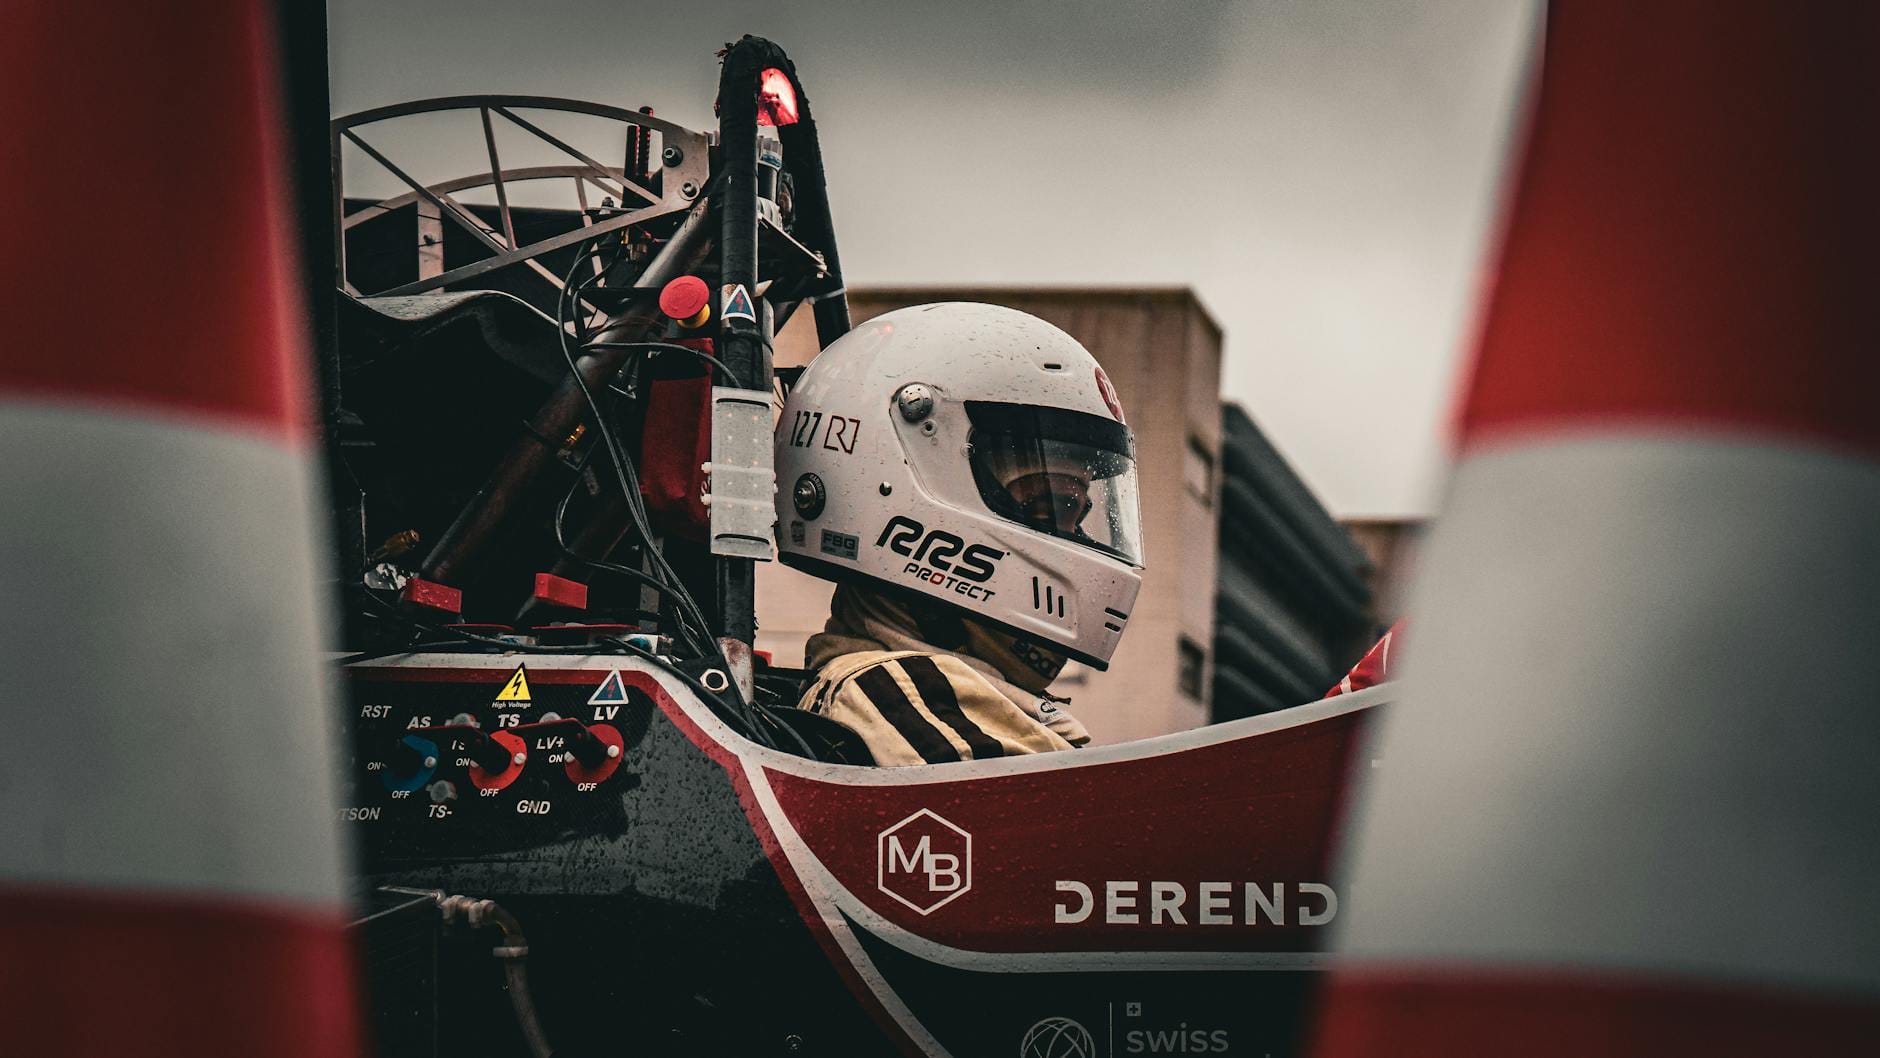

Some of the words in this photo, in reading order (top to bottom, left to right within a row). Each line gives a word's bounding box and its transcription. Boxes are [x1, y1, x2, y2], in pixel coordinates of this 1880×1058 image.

[789, 410, 823, 448] 127
[875, 515, 1005, 583] RRS
[903, 562, 997, 602] PROTECT
[360, 704, 393, 719] RST
[491, 701, 507, 710] High
[508, 701, 532, 710] Voltage
[498, 713, 521, 728] TS
[593, 706, 620, 721] LV
[406, 716, 432, 730] AS
[536, 736, 565, 750] LV+
[367, 761, 381, 771] ON
[455, 757, 470, 767] ON
[548, 754, 563, 764] ON
[391, 790, 411, 799] OFF
[480, 788, 500, 797] OFF
[577, 782, 597, 792] OFF
[429, 804, 453, 819] TS-
[516, 799, 551, 815] GND
[1055, 880, 1340, 926] DEREND
[1126, 1022, 1229, 1053] swiss
